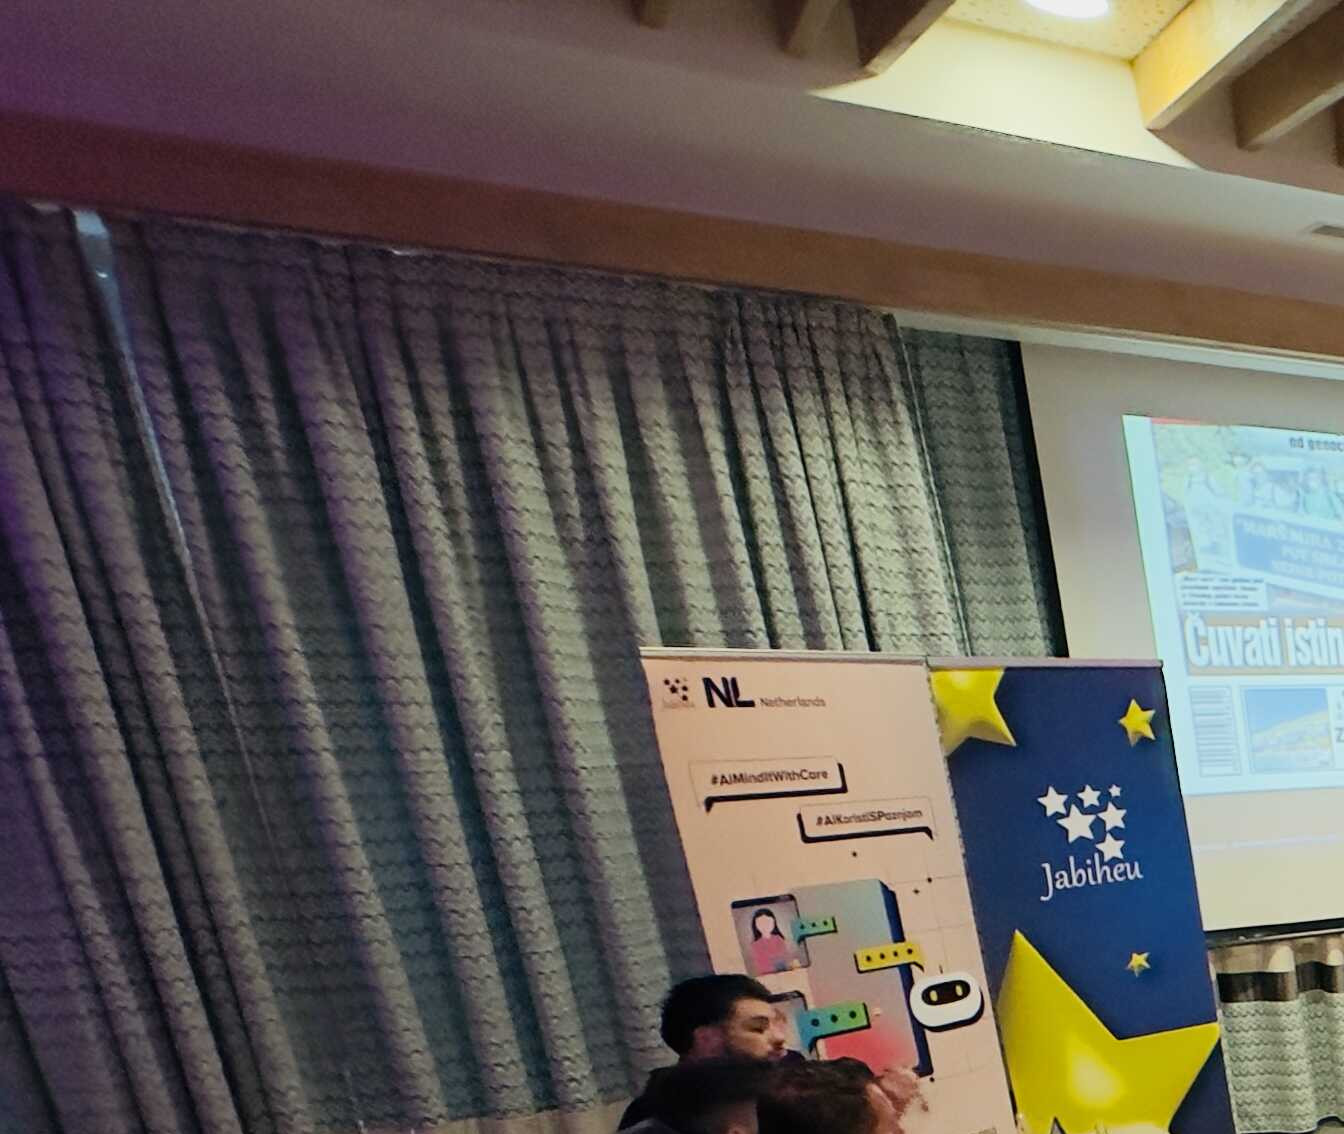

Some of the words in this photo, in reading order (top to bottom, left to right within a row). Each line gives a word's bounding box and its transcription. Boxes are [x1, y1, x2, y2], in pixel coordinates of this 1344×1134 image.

[1184, 610, 1282, 668] Čuvati
[702, 676, 755, 709] NL
[760, 696, 827, 708] Netherlands
[1040, 852, 1144, 901] Jabiheu
